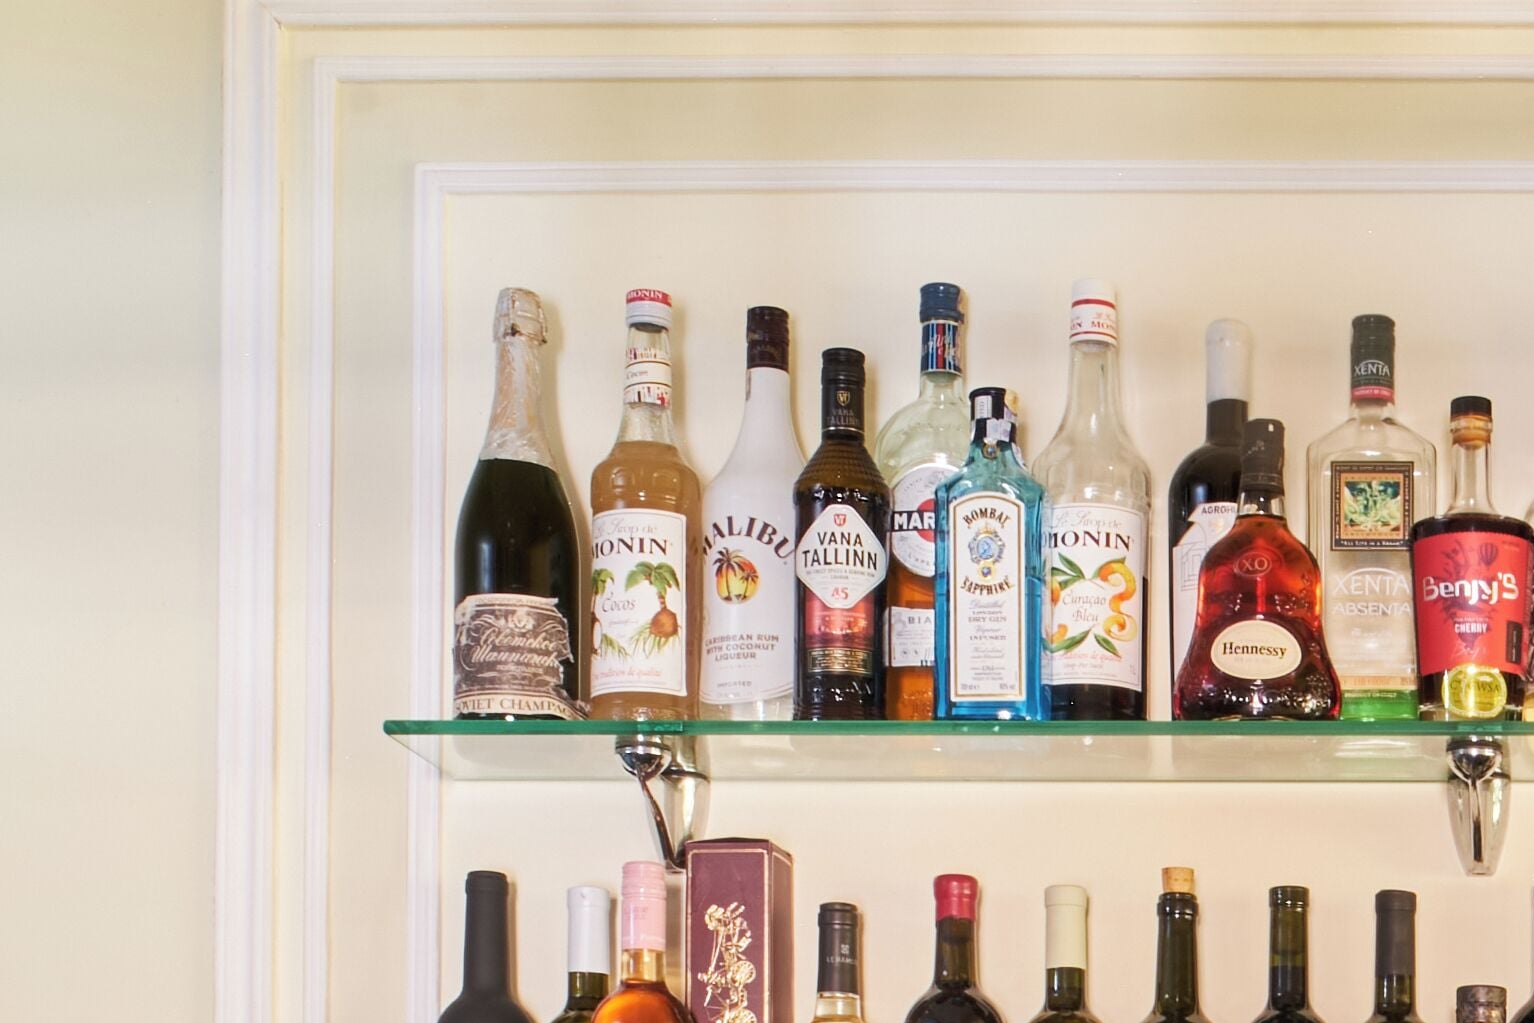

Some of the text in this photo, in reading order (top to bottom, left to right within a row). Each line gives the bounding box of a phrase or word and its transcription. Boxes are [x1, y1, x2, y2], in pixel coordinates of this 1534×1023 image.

[1354, 361, 1391, 377] XENTA
[962, 506, 1012, 527] BOMBAY
[702, 515, 795, 561] MALIBU
[817, 531, 864, 547] VANA
[802, 548, 878, 570] TALLINN
[960, 575, 1014, 595] SAPPHIRE
[1333, 573, 1411, 596] XENTA
[831, 587, 849, 600] 45
[1072, 609, 1100, 623] Bleu
[1332, 601, 1412, 616] ABSENTA
[1454, 621, 1488, 634] CHERRY
[757, 633, 780, 643] RUM
[726, 643, 777, 653] COCONUT
[1221, 641, 1288, 659] Hennessy
[715, 651, 757, 662] LIQUEUR
